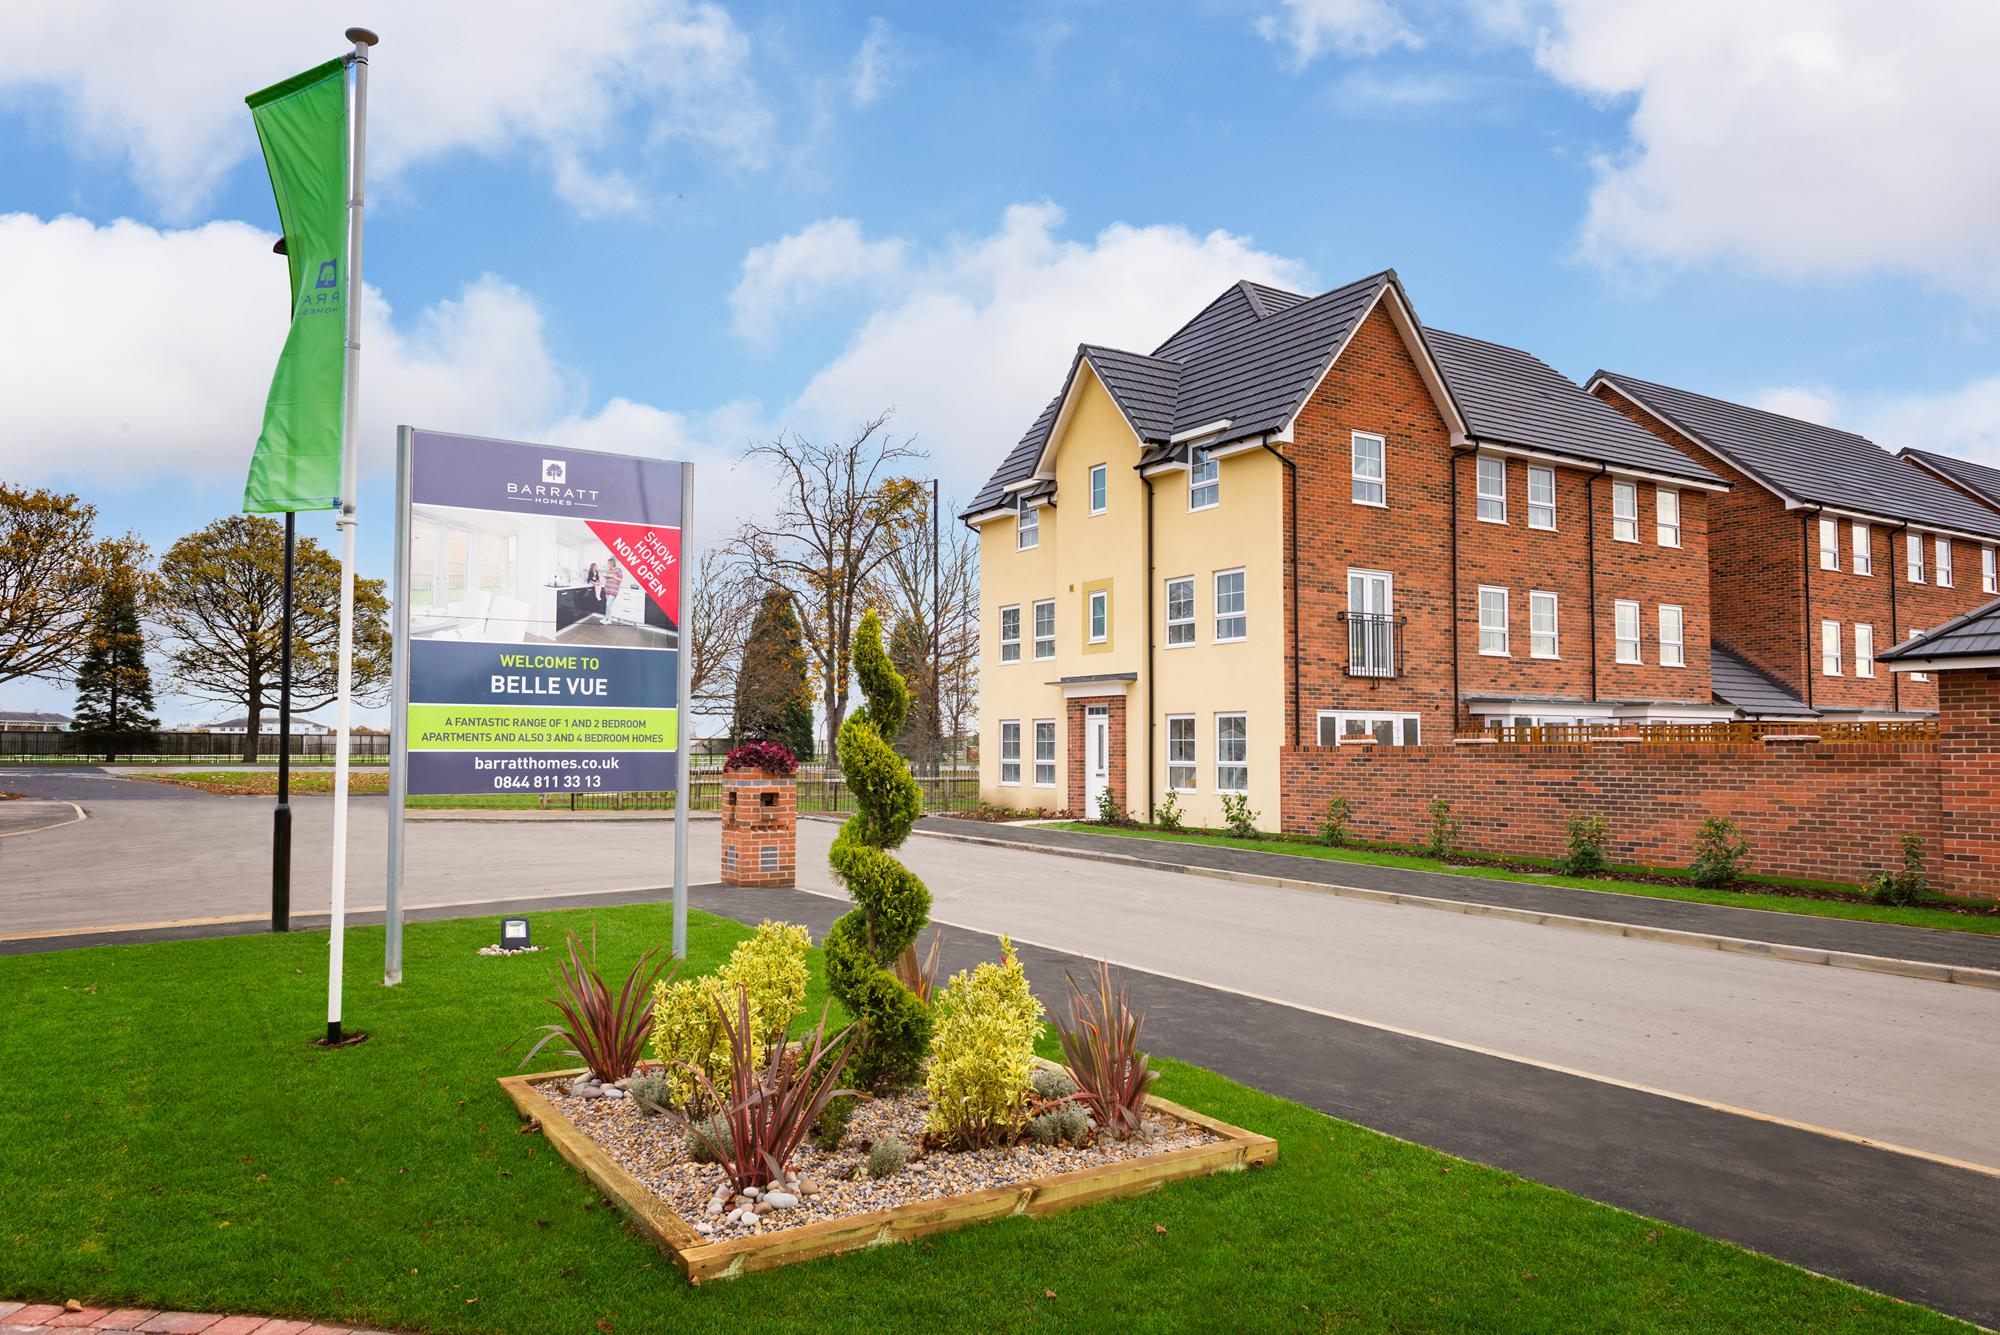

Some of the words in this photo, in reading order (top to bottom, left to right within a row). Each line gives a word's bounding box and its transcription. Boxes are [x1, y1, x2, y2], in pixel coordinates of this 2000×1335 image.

[507, 482, 599, 501] BARRATT
[535, 497, 572, 506] HOMES
[643, 531, 677, 565] SHOW
[634, 540, 666, 576] HOME
[612, 537, 642, 566] NOW
[637, 565, 667, 597] OPEN
[500, 654, 577, 670] WELCOME
[580, 657, 600, 671] TO
[491, 675, 561, 695] BELLE
[566, 677, 608, 696] VUE
[445, 717, 453, 727] A
[455, 717, 511, 727] FANTASTIC
[512, 718, 547, 727] RANGE
[549, 718, 562, 727] OF
[564, 719, 569, 727] 1
[571, 719, 592, 728] AND
[594, 719, 600, 728] 2
[601, 719, 647, 729] BEDROOM
[421, 732, 492, 742] APARTMENTS
[494, 732, 516, 742] AND
[518, 733, 544, 742] ALSO
[546, 733, 552, 742] 3
[553, 733, 575, 742] AND
[576, 734, 583, 742] 4
[584, 733, 630, 743] BEDROOM
[632, 734, 664, 743] HOMES
[474, 757, 620, 770] barratthomes.co.uk
[494, 775, 530, 789] 0844
[533, 775, 559, 788] 811
[563, 775, 581, 788] 33
[585, 775, 601, 788] 13
